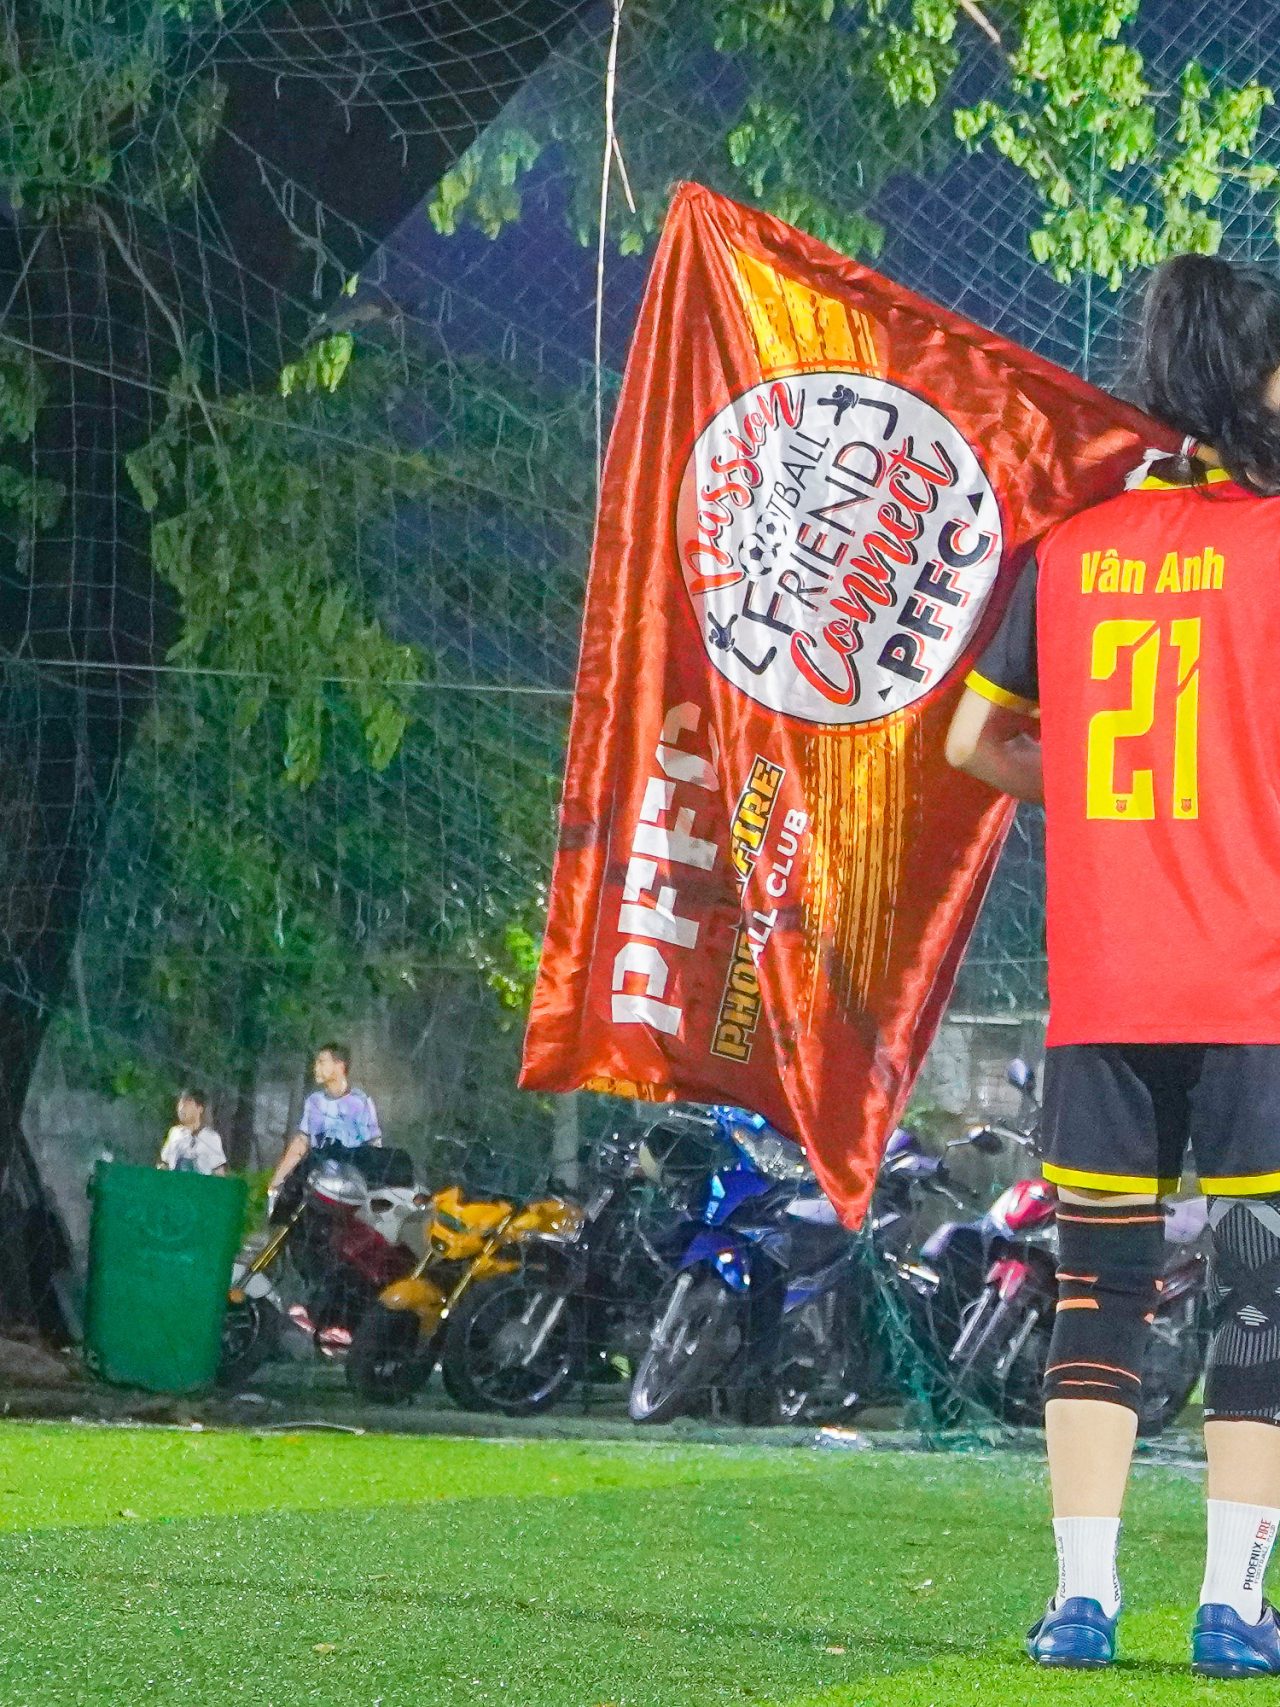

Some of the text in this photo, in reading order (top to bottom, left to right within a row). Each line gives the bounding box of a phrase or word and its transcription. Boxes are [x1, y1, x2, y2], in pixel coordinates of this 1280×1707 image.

[741, 441, 887, 637] FRIEND
[789, 435, 959, 706] Connect
[876, 517, 999, 684] PFFC
[1081, 546, 1225, 594] Vân Anh
[1086, 616, 1200, 820] 21
[611, 701, 719, 1035] PFFC
[765, 808, 808, 897] CLUB
[1243, 1518, 1271, 1590] PHOENIX FIRE
